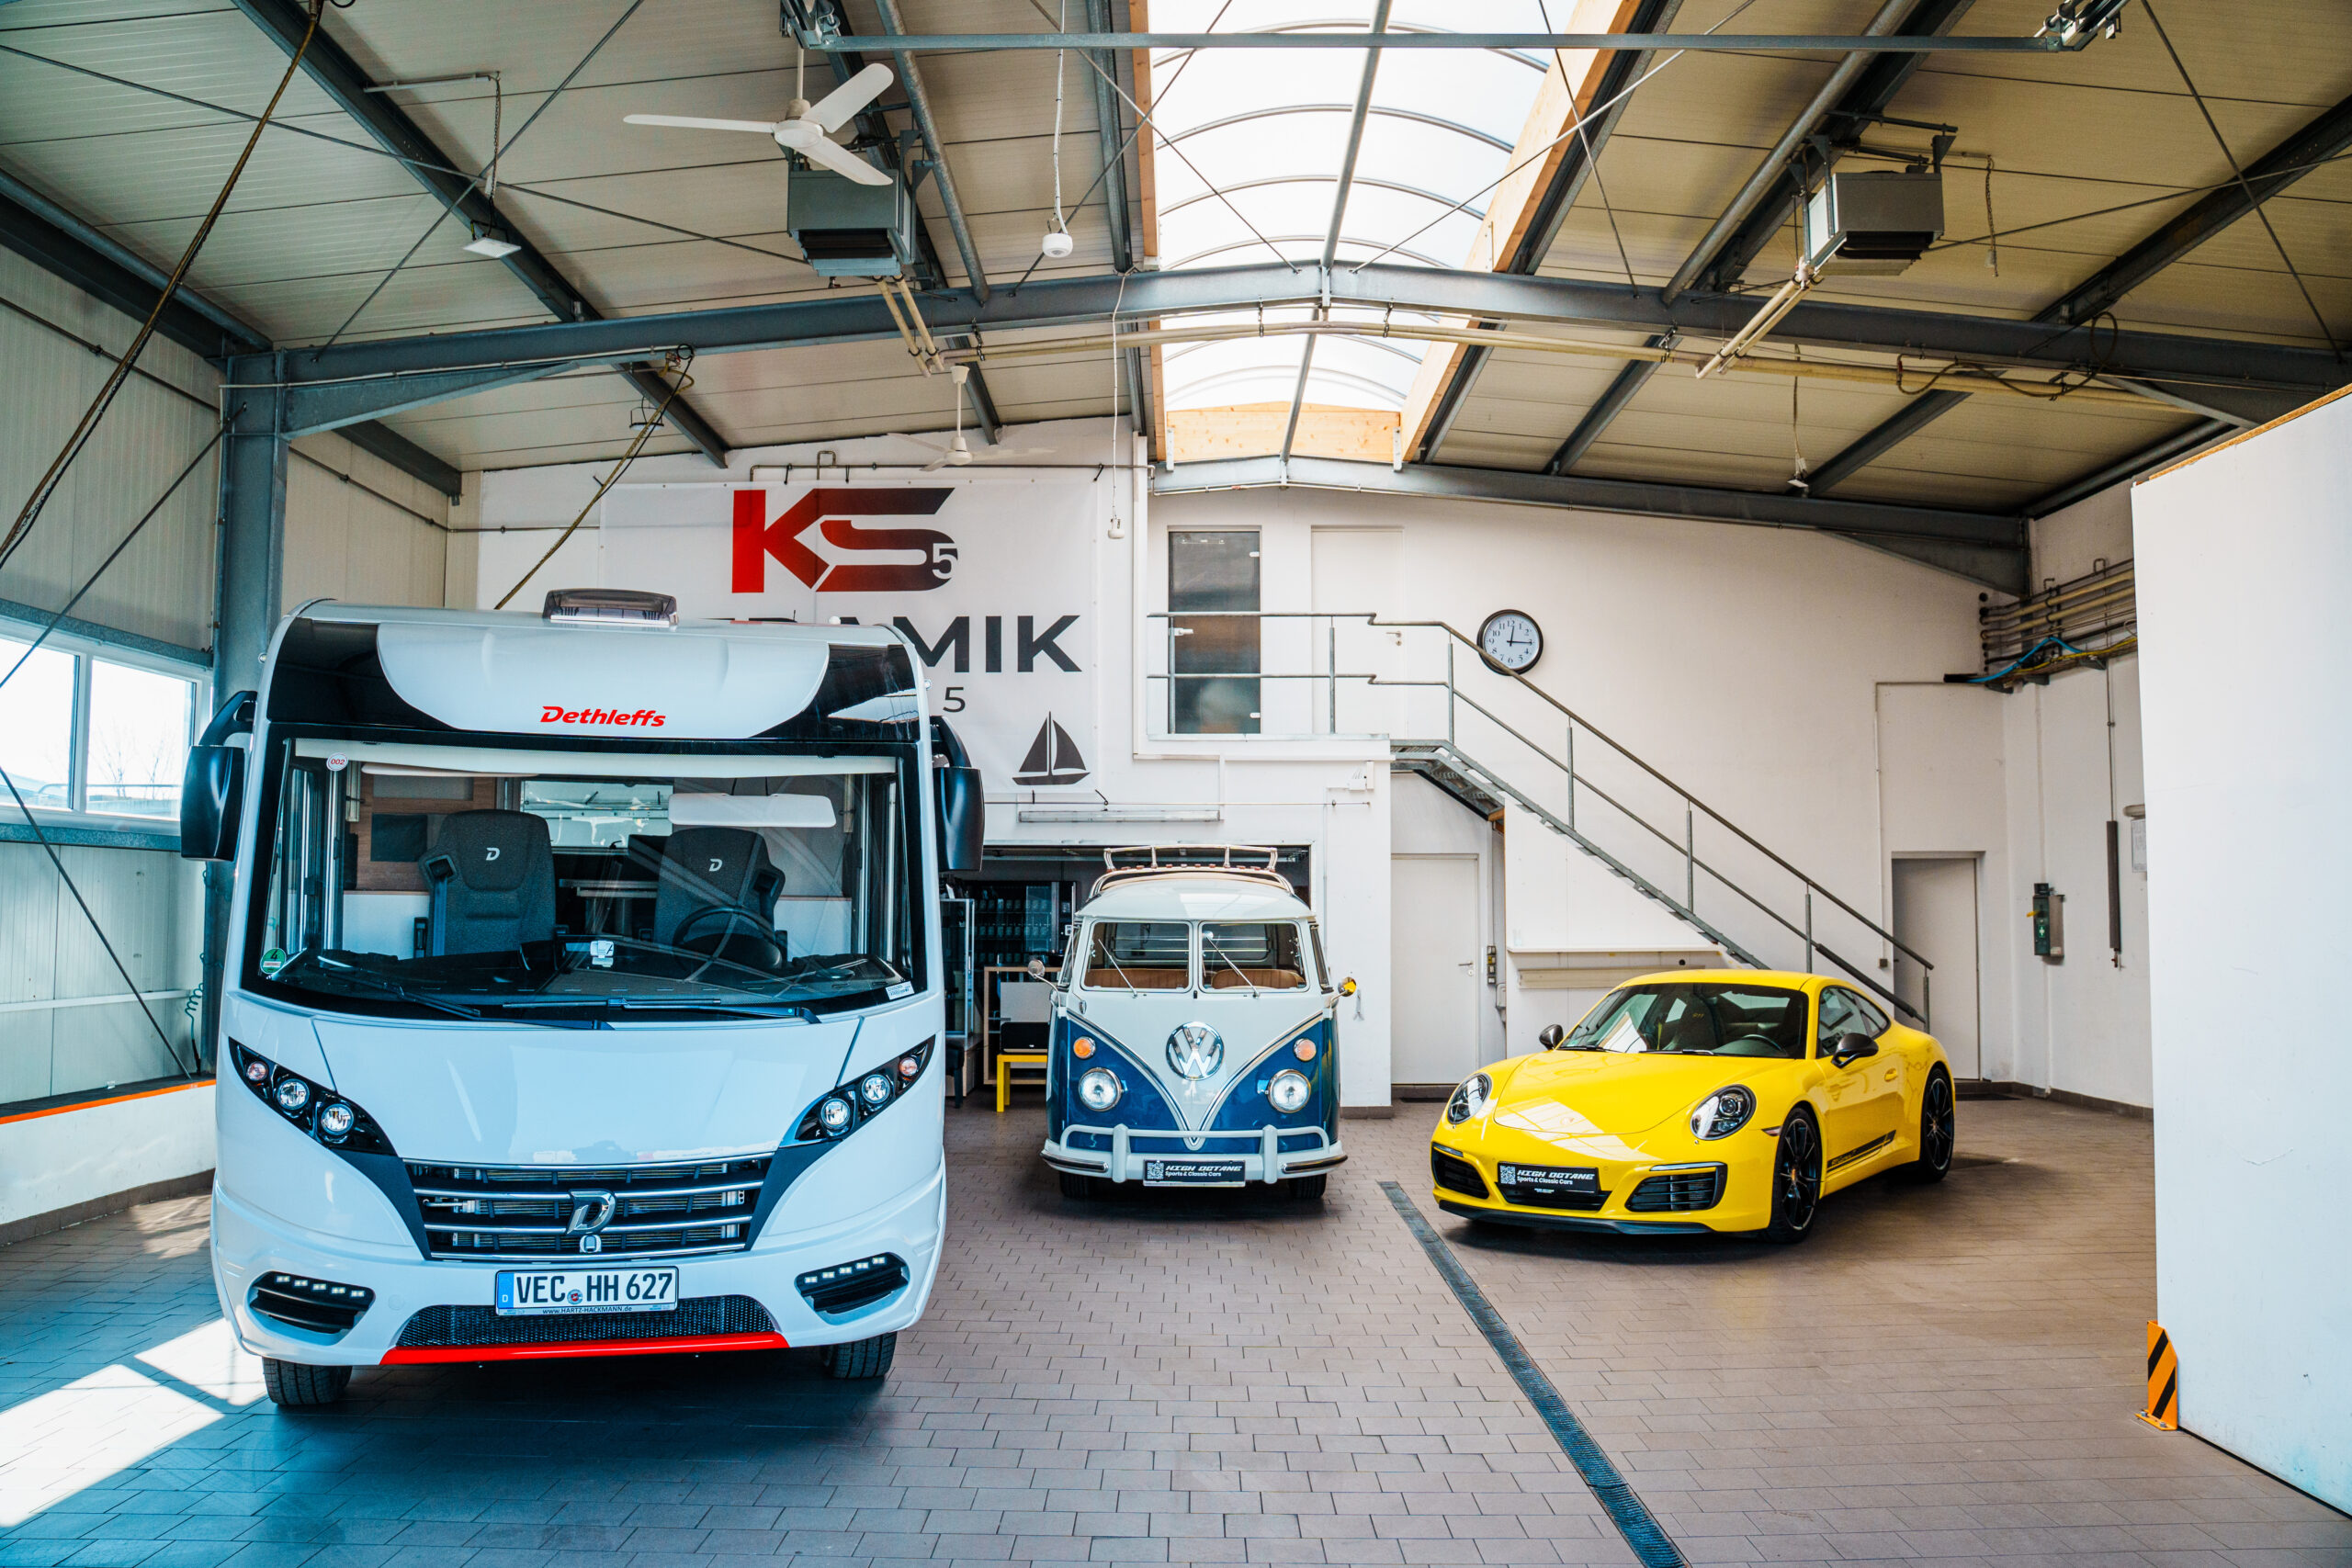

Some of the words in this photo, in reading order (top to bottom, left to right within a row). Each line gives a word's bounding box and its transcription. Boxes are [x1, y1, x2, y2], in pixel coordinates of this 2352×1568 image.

[732, 488, 958, 593] KS
[932, 542, 958, 580] 5
[1524, 628, 1530, 637] 2
[1491, 647, 1498, 655] 8
[1499, 653, 1504, 661] 7
[1518, 654, 1523, 663] 5
[540, 705, 666, 728] Dethleffs
[270, 949, 278, 960] 4
[1517, 1169, 1546, 1178] HIGH
[1548, 1171, 1595, 1180] OCTANE
[502, 1294, 508, 1303] D
[516, 1275, 566, 1303] VEC
[586, 1274, 619, 1302] HH
[626, 1273, 673, 1301] 627
[542, 1305, 632, 1314] www.HARTZ-HACKMANN.de
